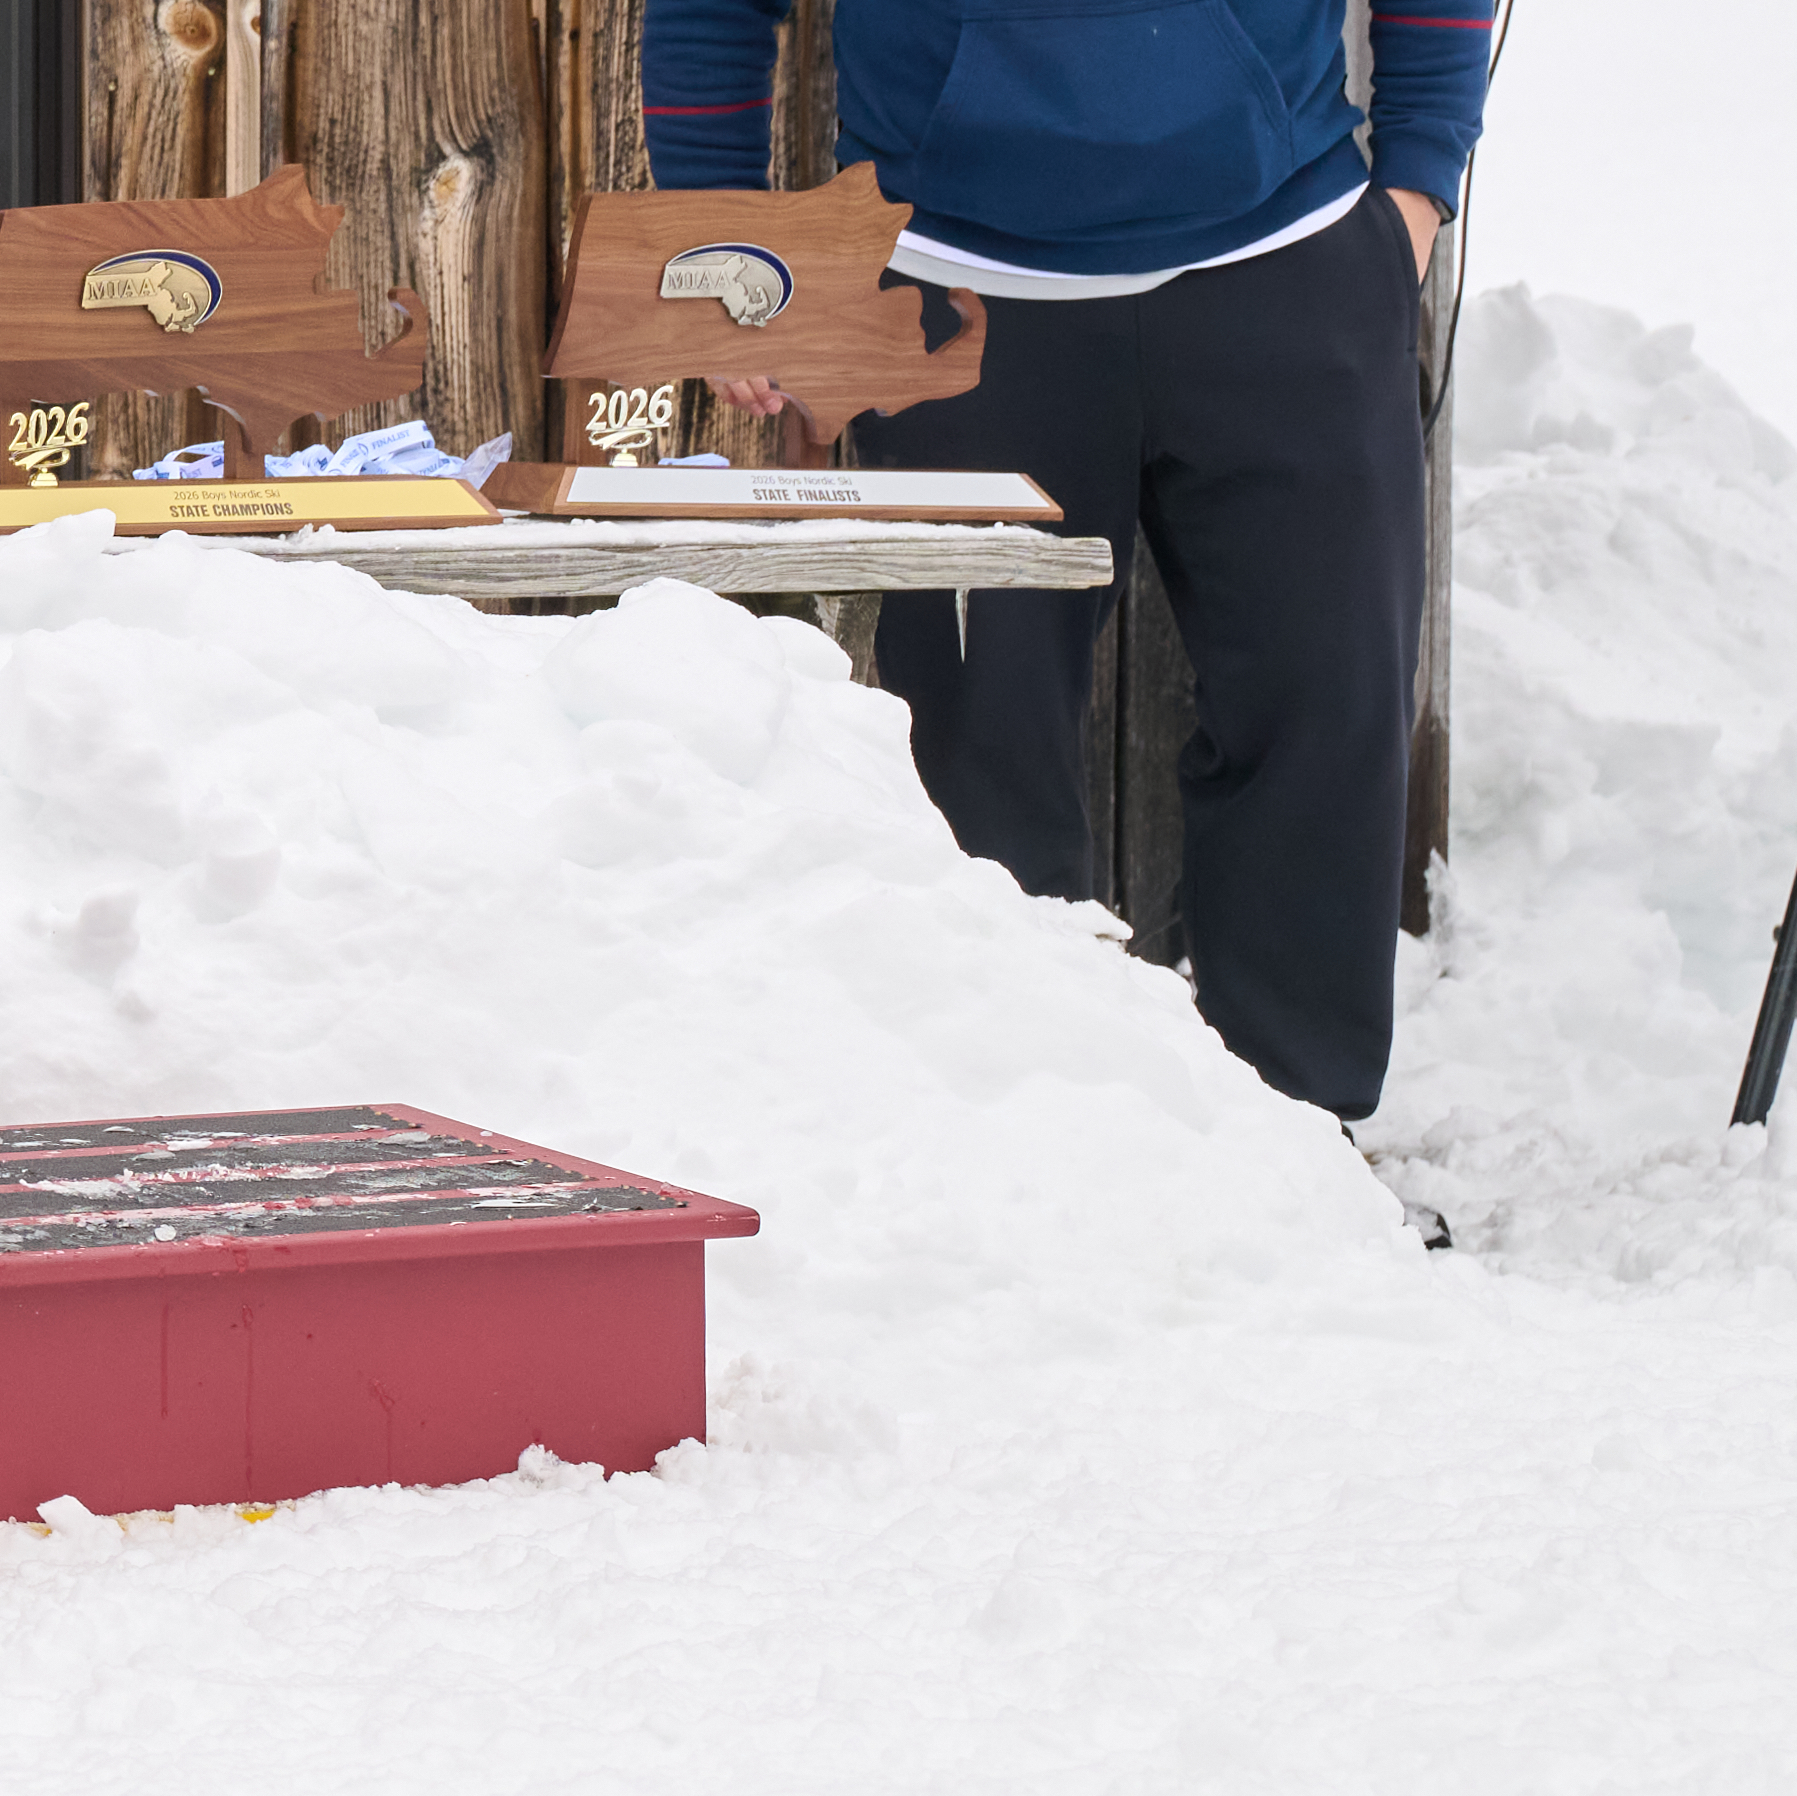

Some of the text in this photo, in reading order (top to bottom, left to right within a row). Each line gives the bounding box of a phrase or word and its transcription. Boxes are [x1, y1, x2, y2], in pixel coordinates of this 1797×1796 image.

[87, 277, 158, 301] MIAA
[667, 269, 732, 291] MIAA
[585, 384, 674, 431] 2026
[8, 401, 90, 451] 2026
[750, 475, 853, 487] 2026 Boys Nordic Ski
[173, 489, 281, 501] 2026 Boys Nordic Ski
[752, 488, 861, 502] STATE FINALISTS
[169, 502, 294, 518] STATE CHAMPIONS
